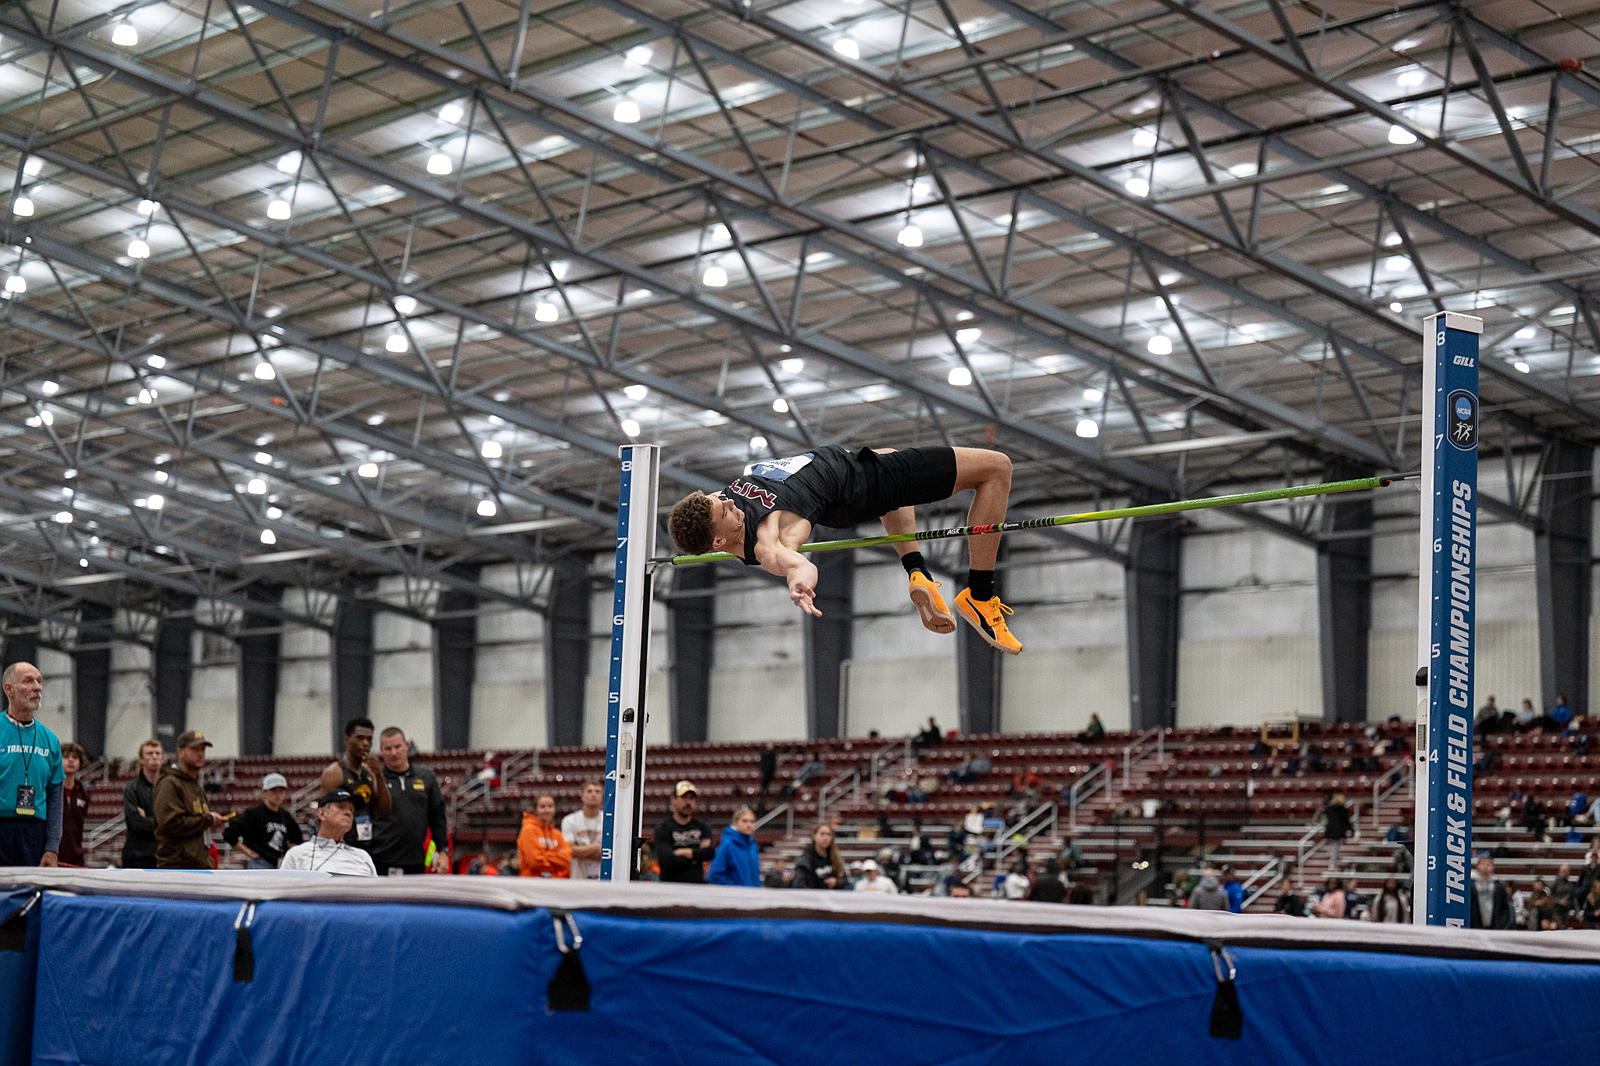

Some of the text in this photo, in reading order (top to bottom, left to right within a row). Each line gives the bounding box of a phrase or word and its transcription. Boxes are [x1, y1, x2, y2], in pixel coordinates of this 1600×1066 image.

[1436, 331, 1446, 346] 8
[1452, 355, 1475, 368] GILL
[1457, 407, 1471, 416] NCAA
[1435, 433, 1444, 450] 7
[621, 461, 632, 472] 8
[617, 537, 628, 549] 7
[1433, 538, 1442, 553] 6
[1449, 479, 1472, 709] CHAMPIONSHIPS
[613, 614, 624, 626] 6
[1431, 643, 1441, 658] 5
[608, 691, 619, 703] 5
[1429, 749, 1439, 764] 4
[1447, 713, 1468, 790] FIELD
[605, 770, 617, 781] 4
[1447, 792, 1466, 814] &
[601, 848, 613, 859] 3
[1445, 815, 1466, 904] TRACK
[1428, 855, 1436, 870] 3
